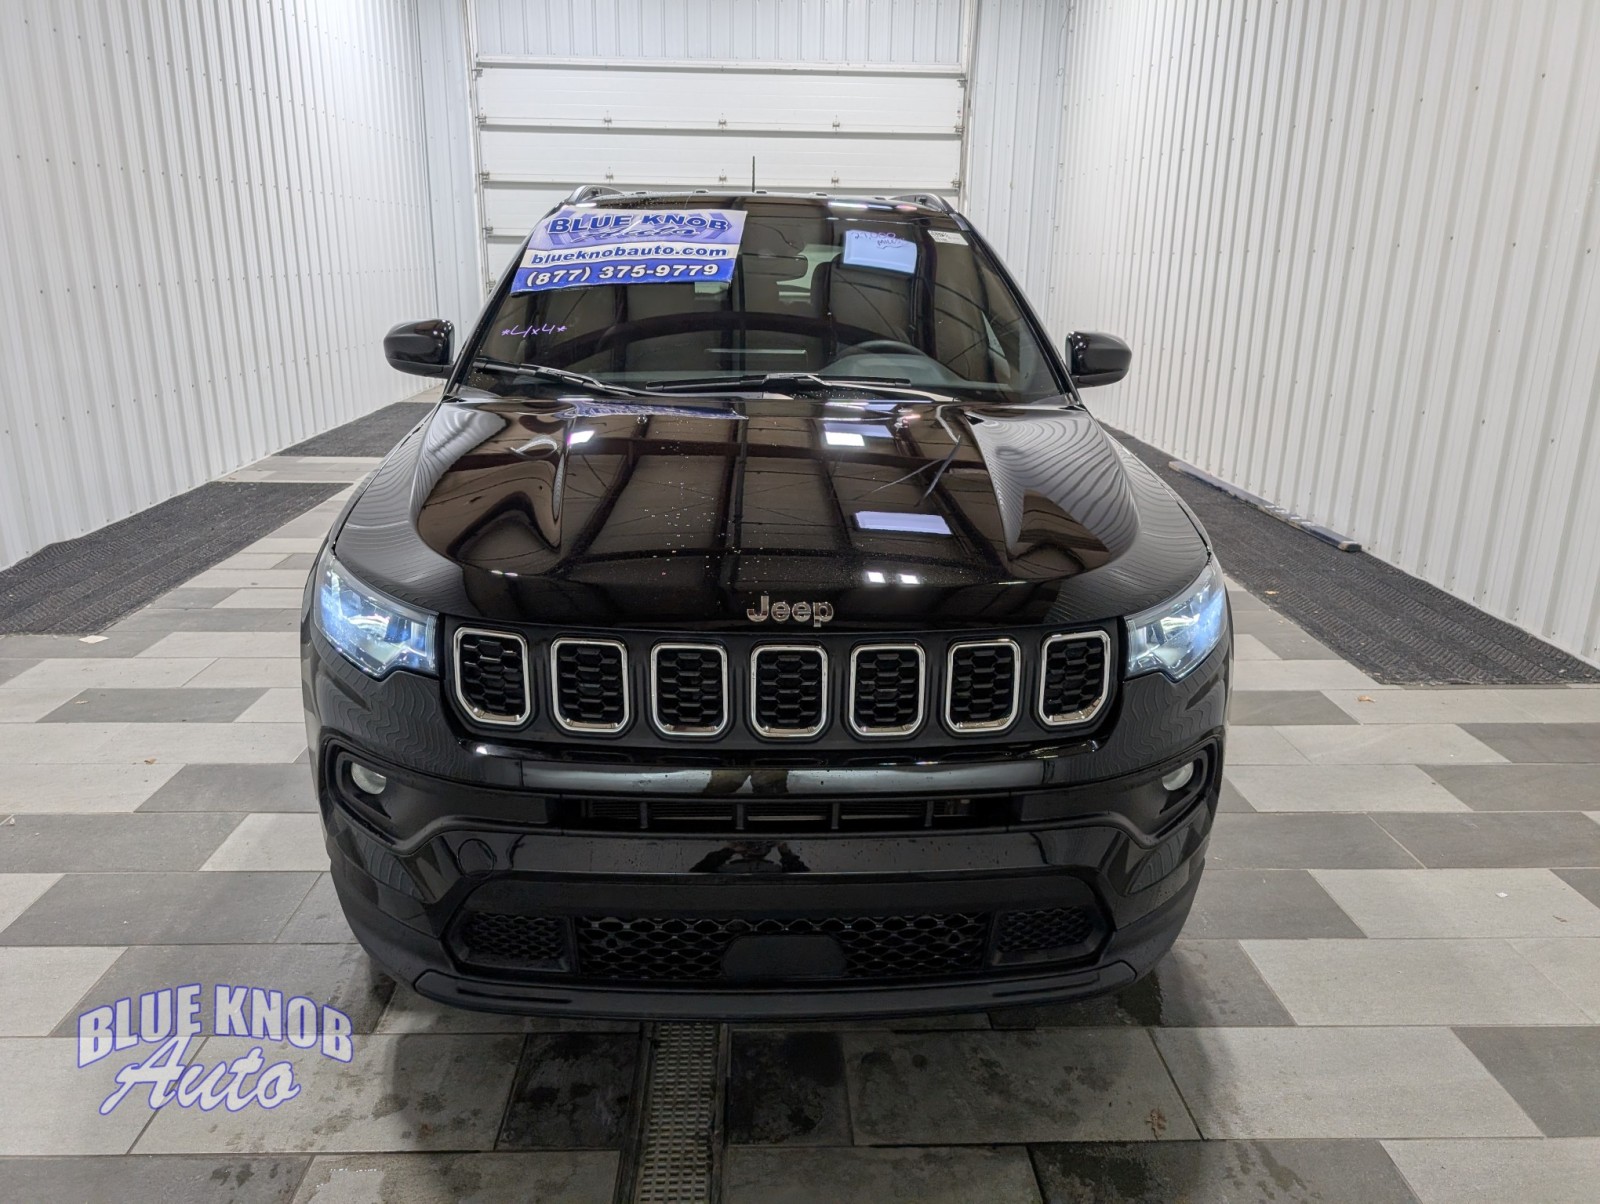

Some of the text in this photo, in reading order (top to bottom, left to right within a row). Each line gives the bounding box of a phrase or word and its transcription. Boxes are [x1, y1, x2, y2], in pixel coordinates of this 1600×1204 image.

[548, 213, 729, 234] BLUE KNOB
[531, 245, 728, 265] blueknobauto.com
[526, 263, 719, 287] (877) 375-9779
[746, 595, 834, 628] Jeep
